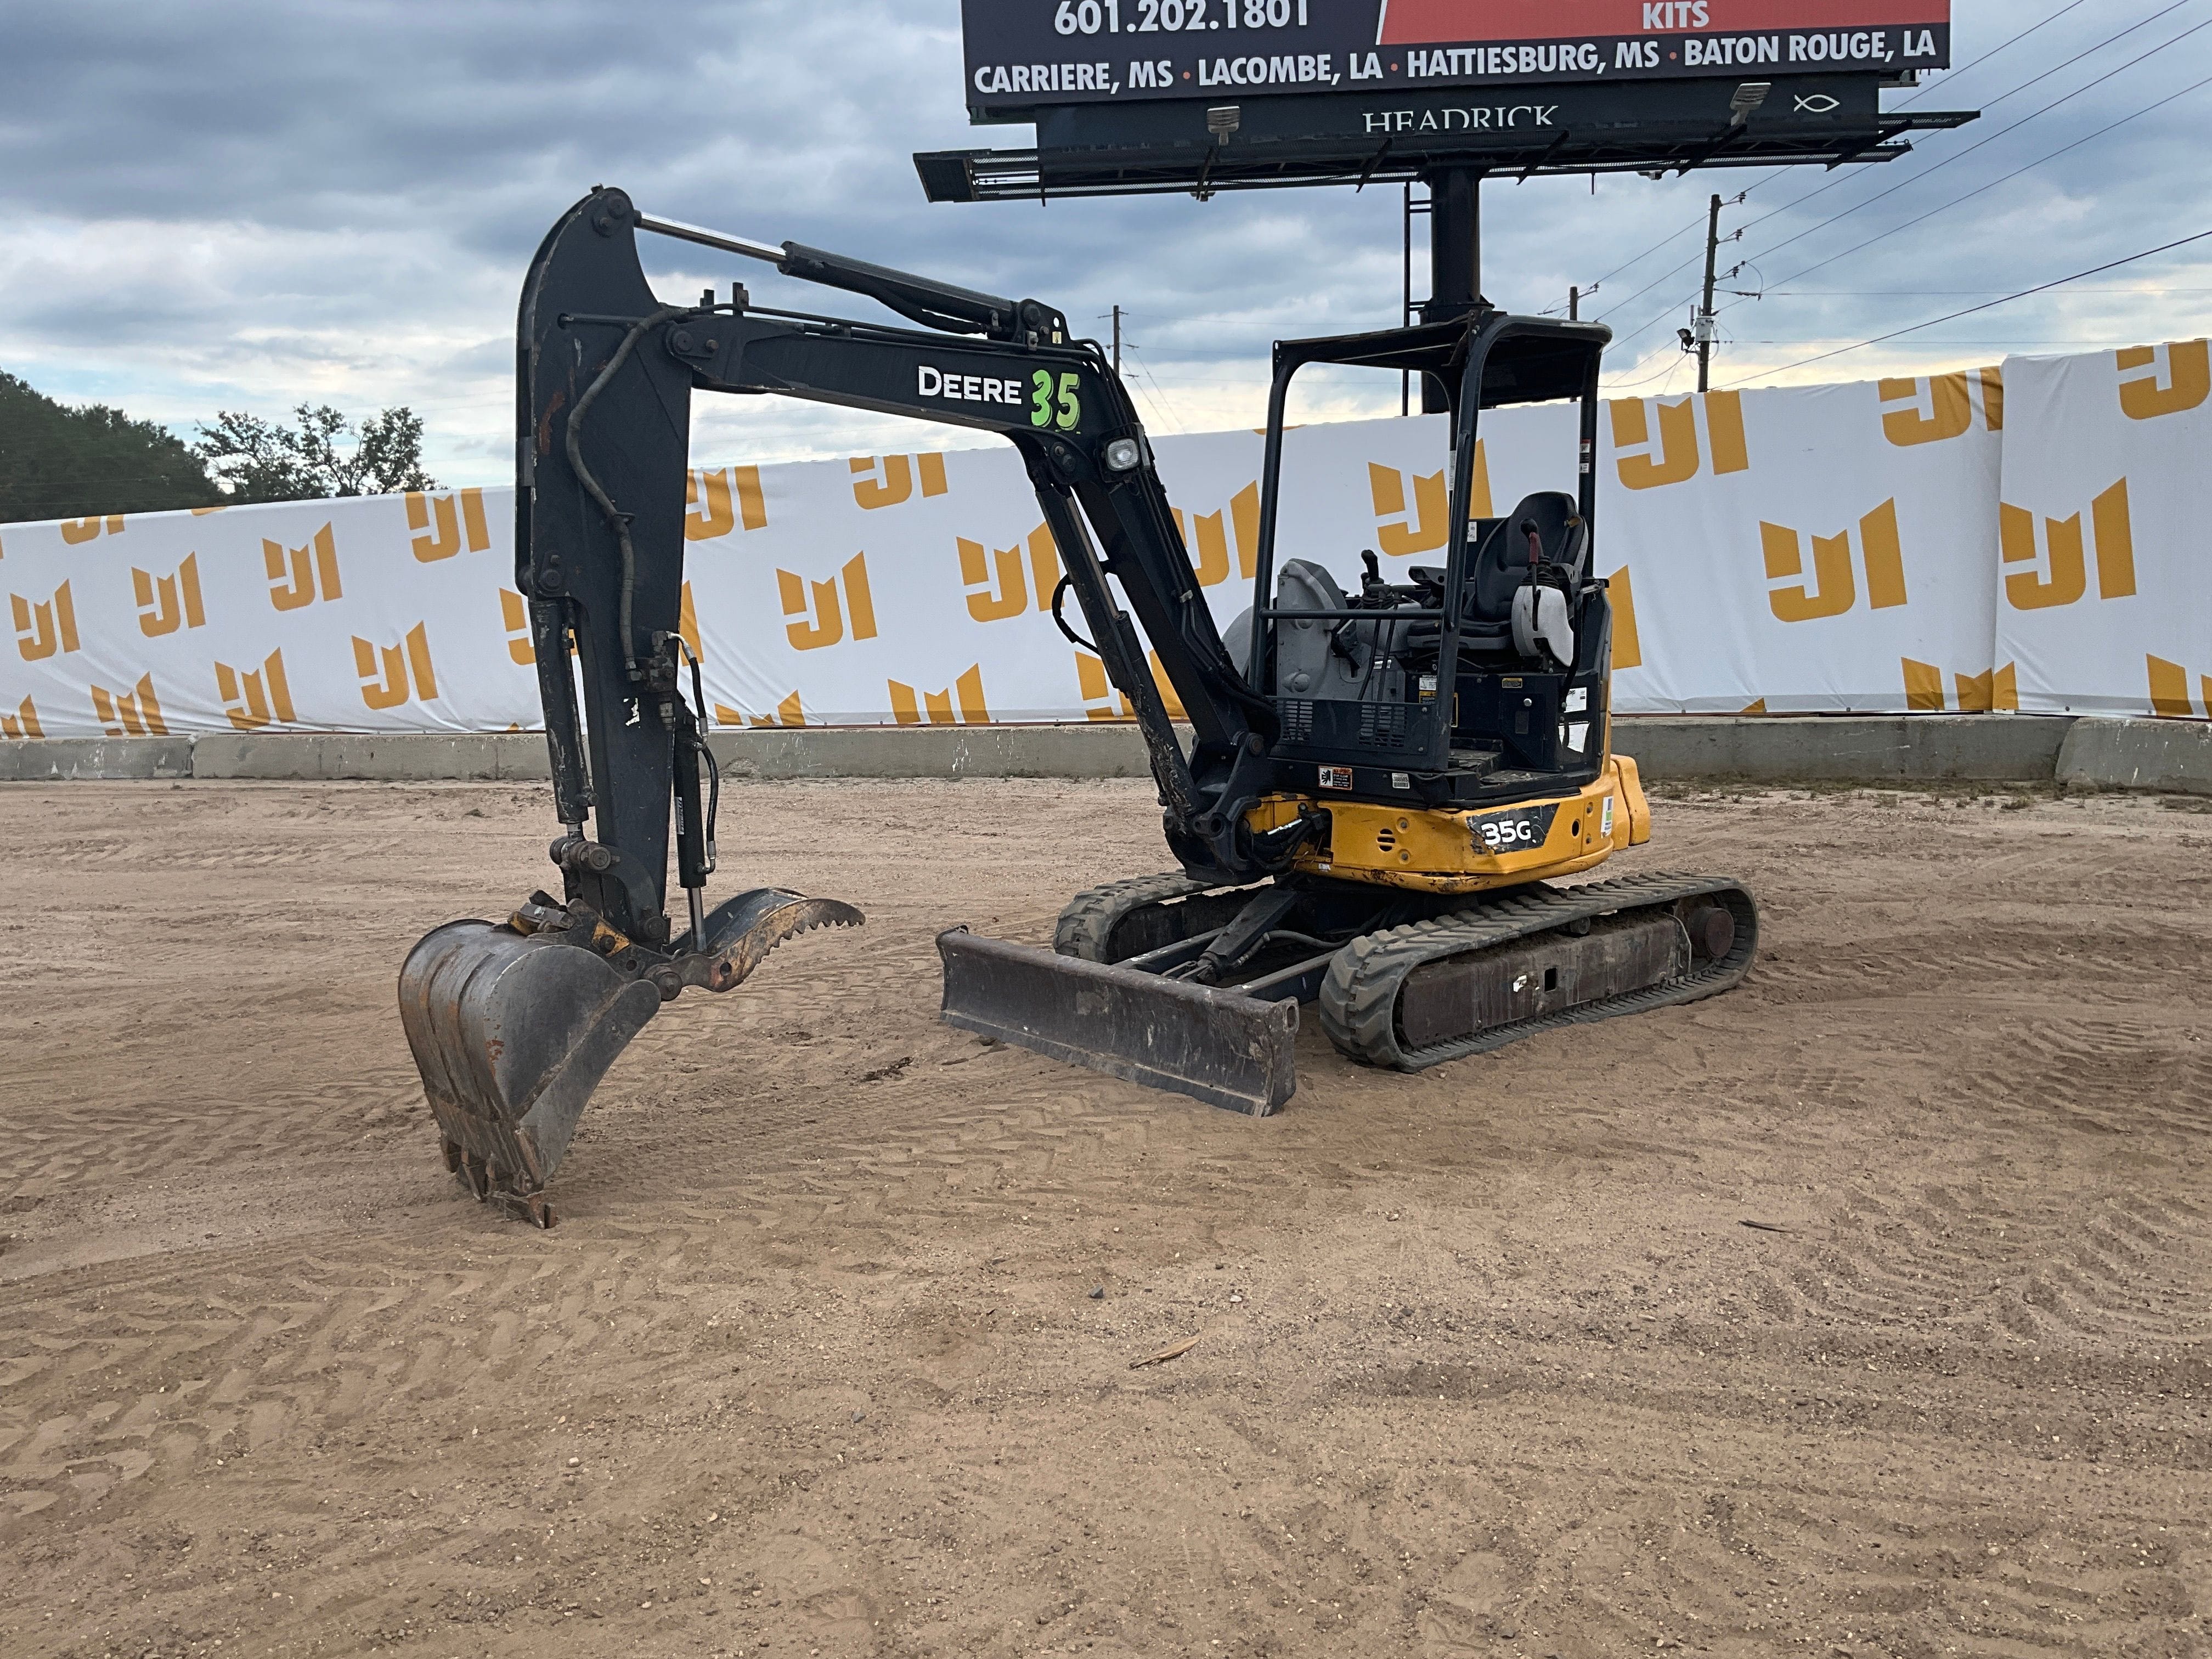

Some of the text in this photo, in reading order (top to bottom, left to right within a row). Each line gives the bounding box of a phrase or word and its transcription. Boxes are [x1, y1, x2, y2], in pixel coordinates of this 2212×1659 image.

[1054, 0, 1307, 35] 601.202.1801
[1643, 0, 1710, 30] KITS
[974, 30, 1937, 94] CARRIERE, MS LACOMBE, LA HATTIESBURG, MS BATON ROUGE, LA
[1362, 105, 1559, 132] HEADRICK
[918, 365, 1080, 431] DEERE 35
[1481, 820, 1532, 846] 35G
